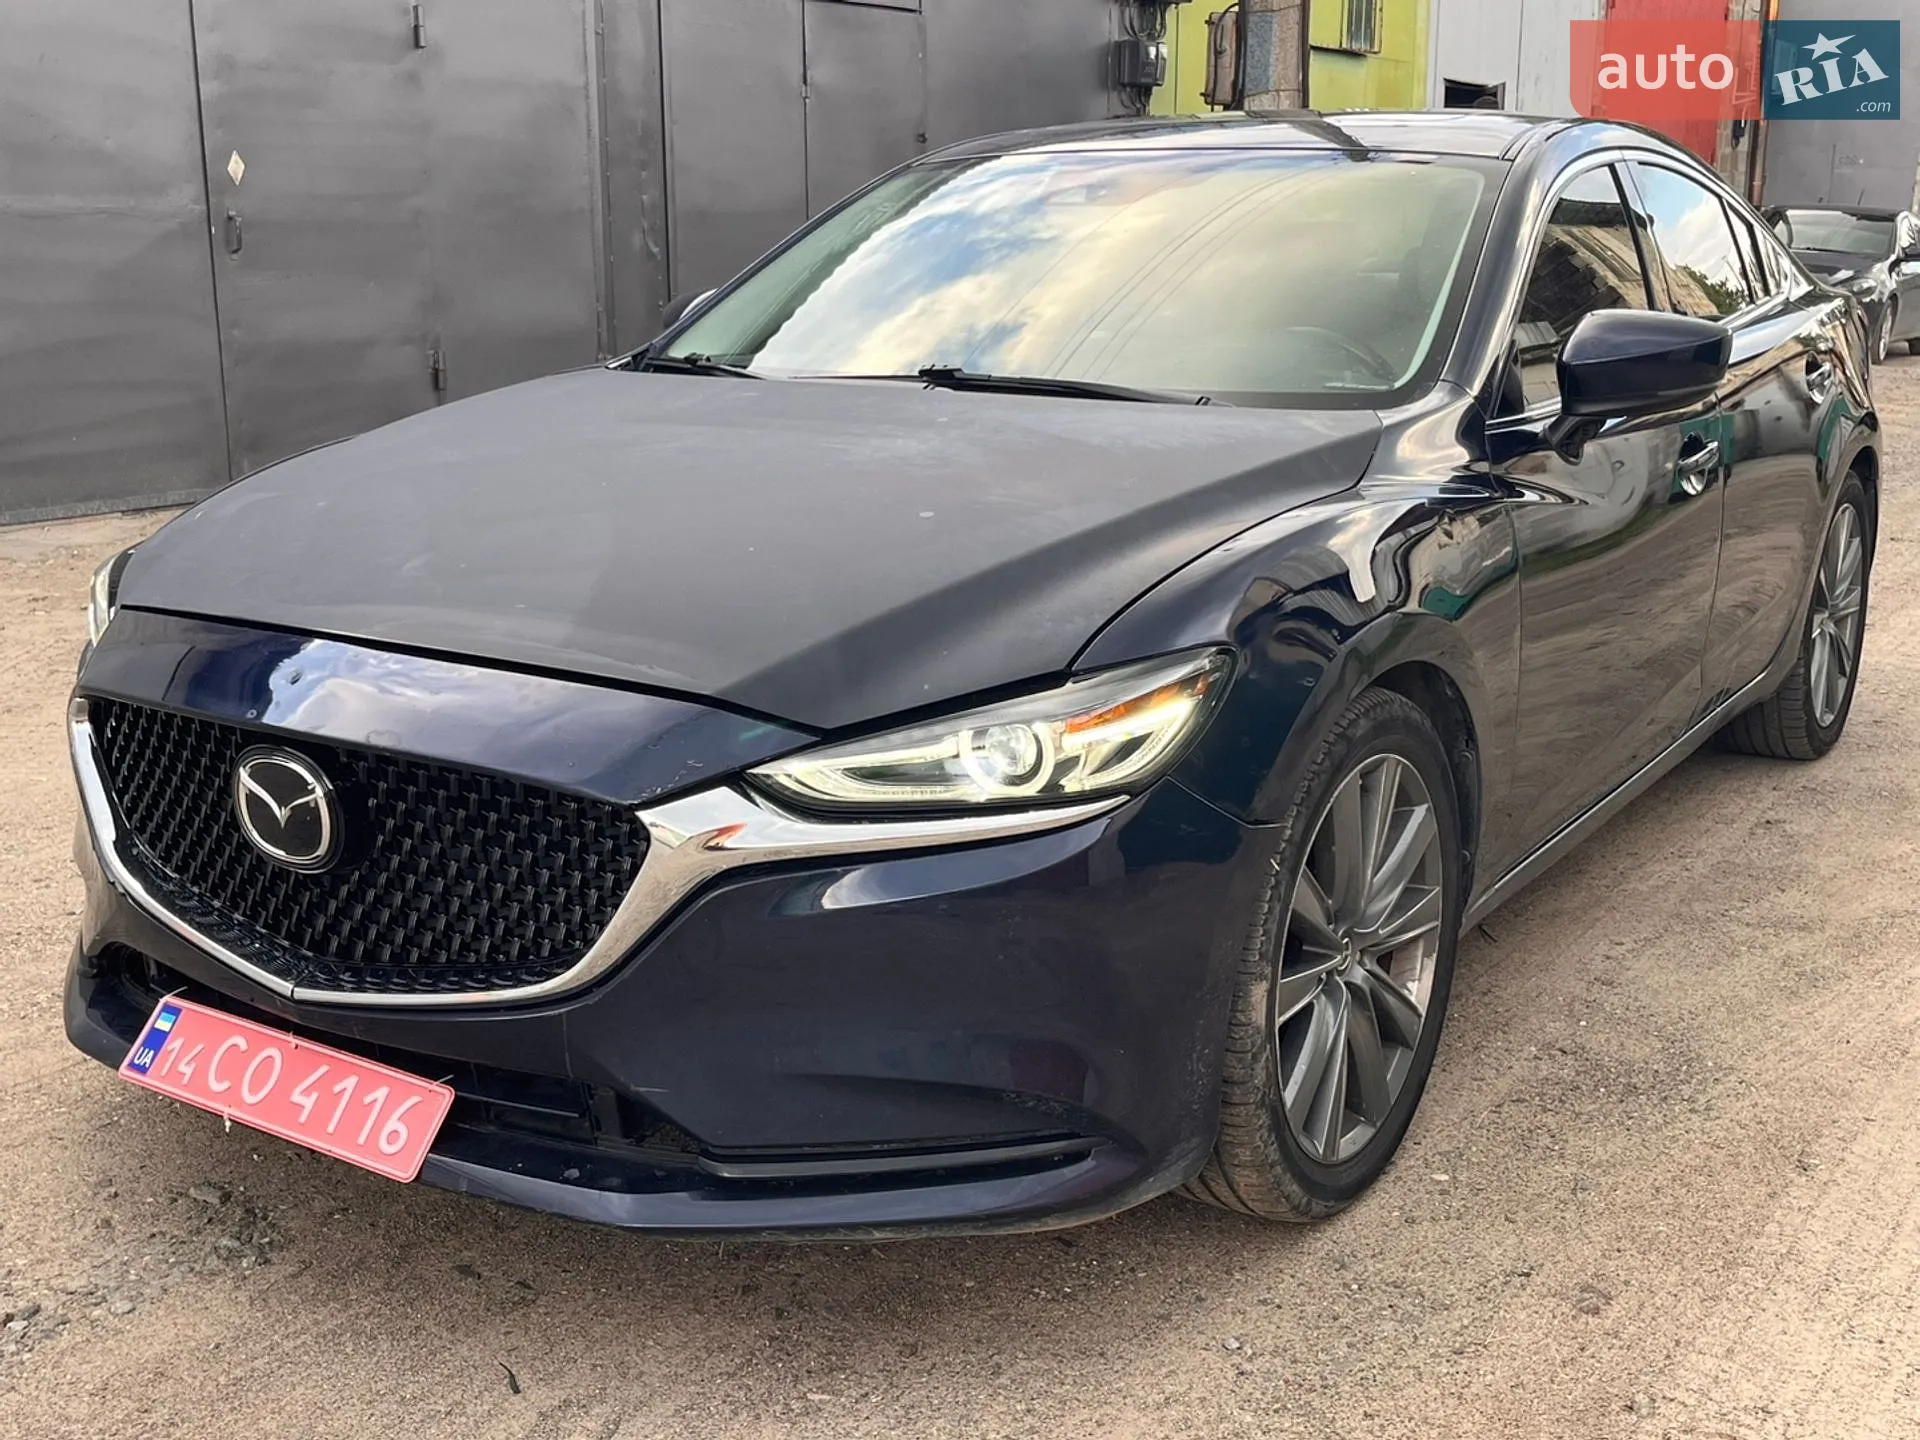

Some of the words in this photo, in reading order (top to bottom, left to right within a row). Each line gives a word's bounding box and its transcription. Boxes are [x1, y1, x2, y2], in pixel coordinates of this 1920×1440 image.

[134, 1046, 154, 1068] UA
[160, 1037, 205, 1086] 14
[208, 1035, 283, 1105] CO
[289, 1064, 423, 1155] 4116
